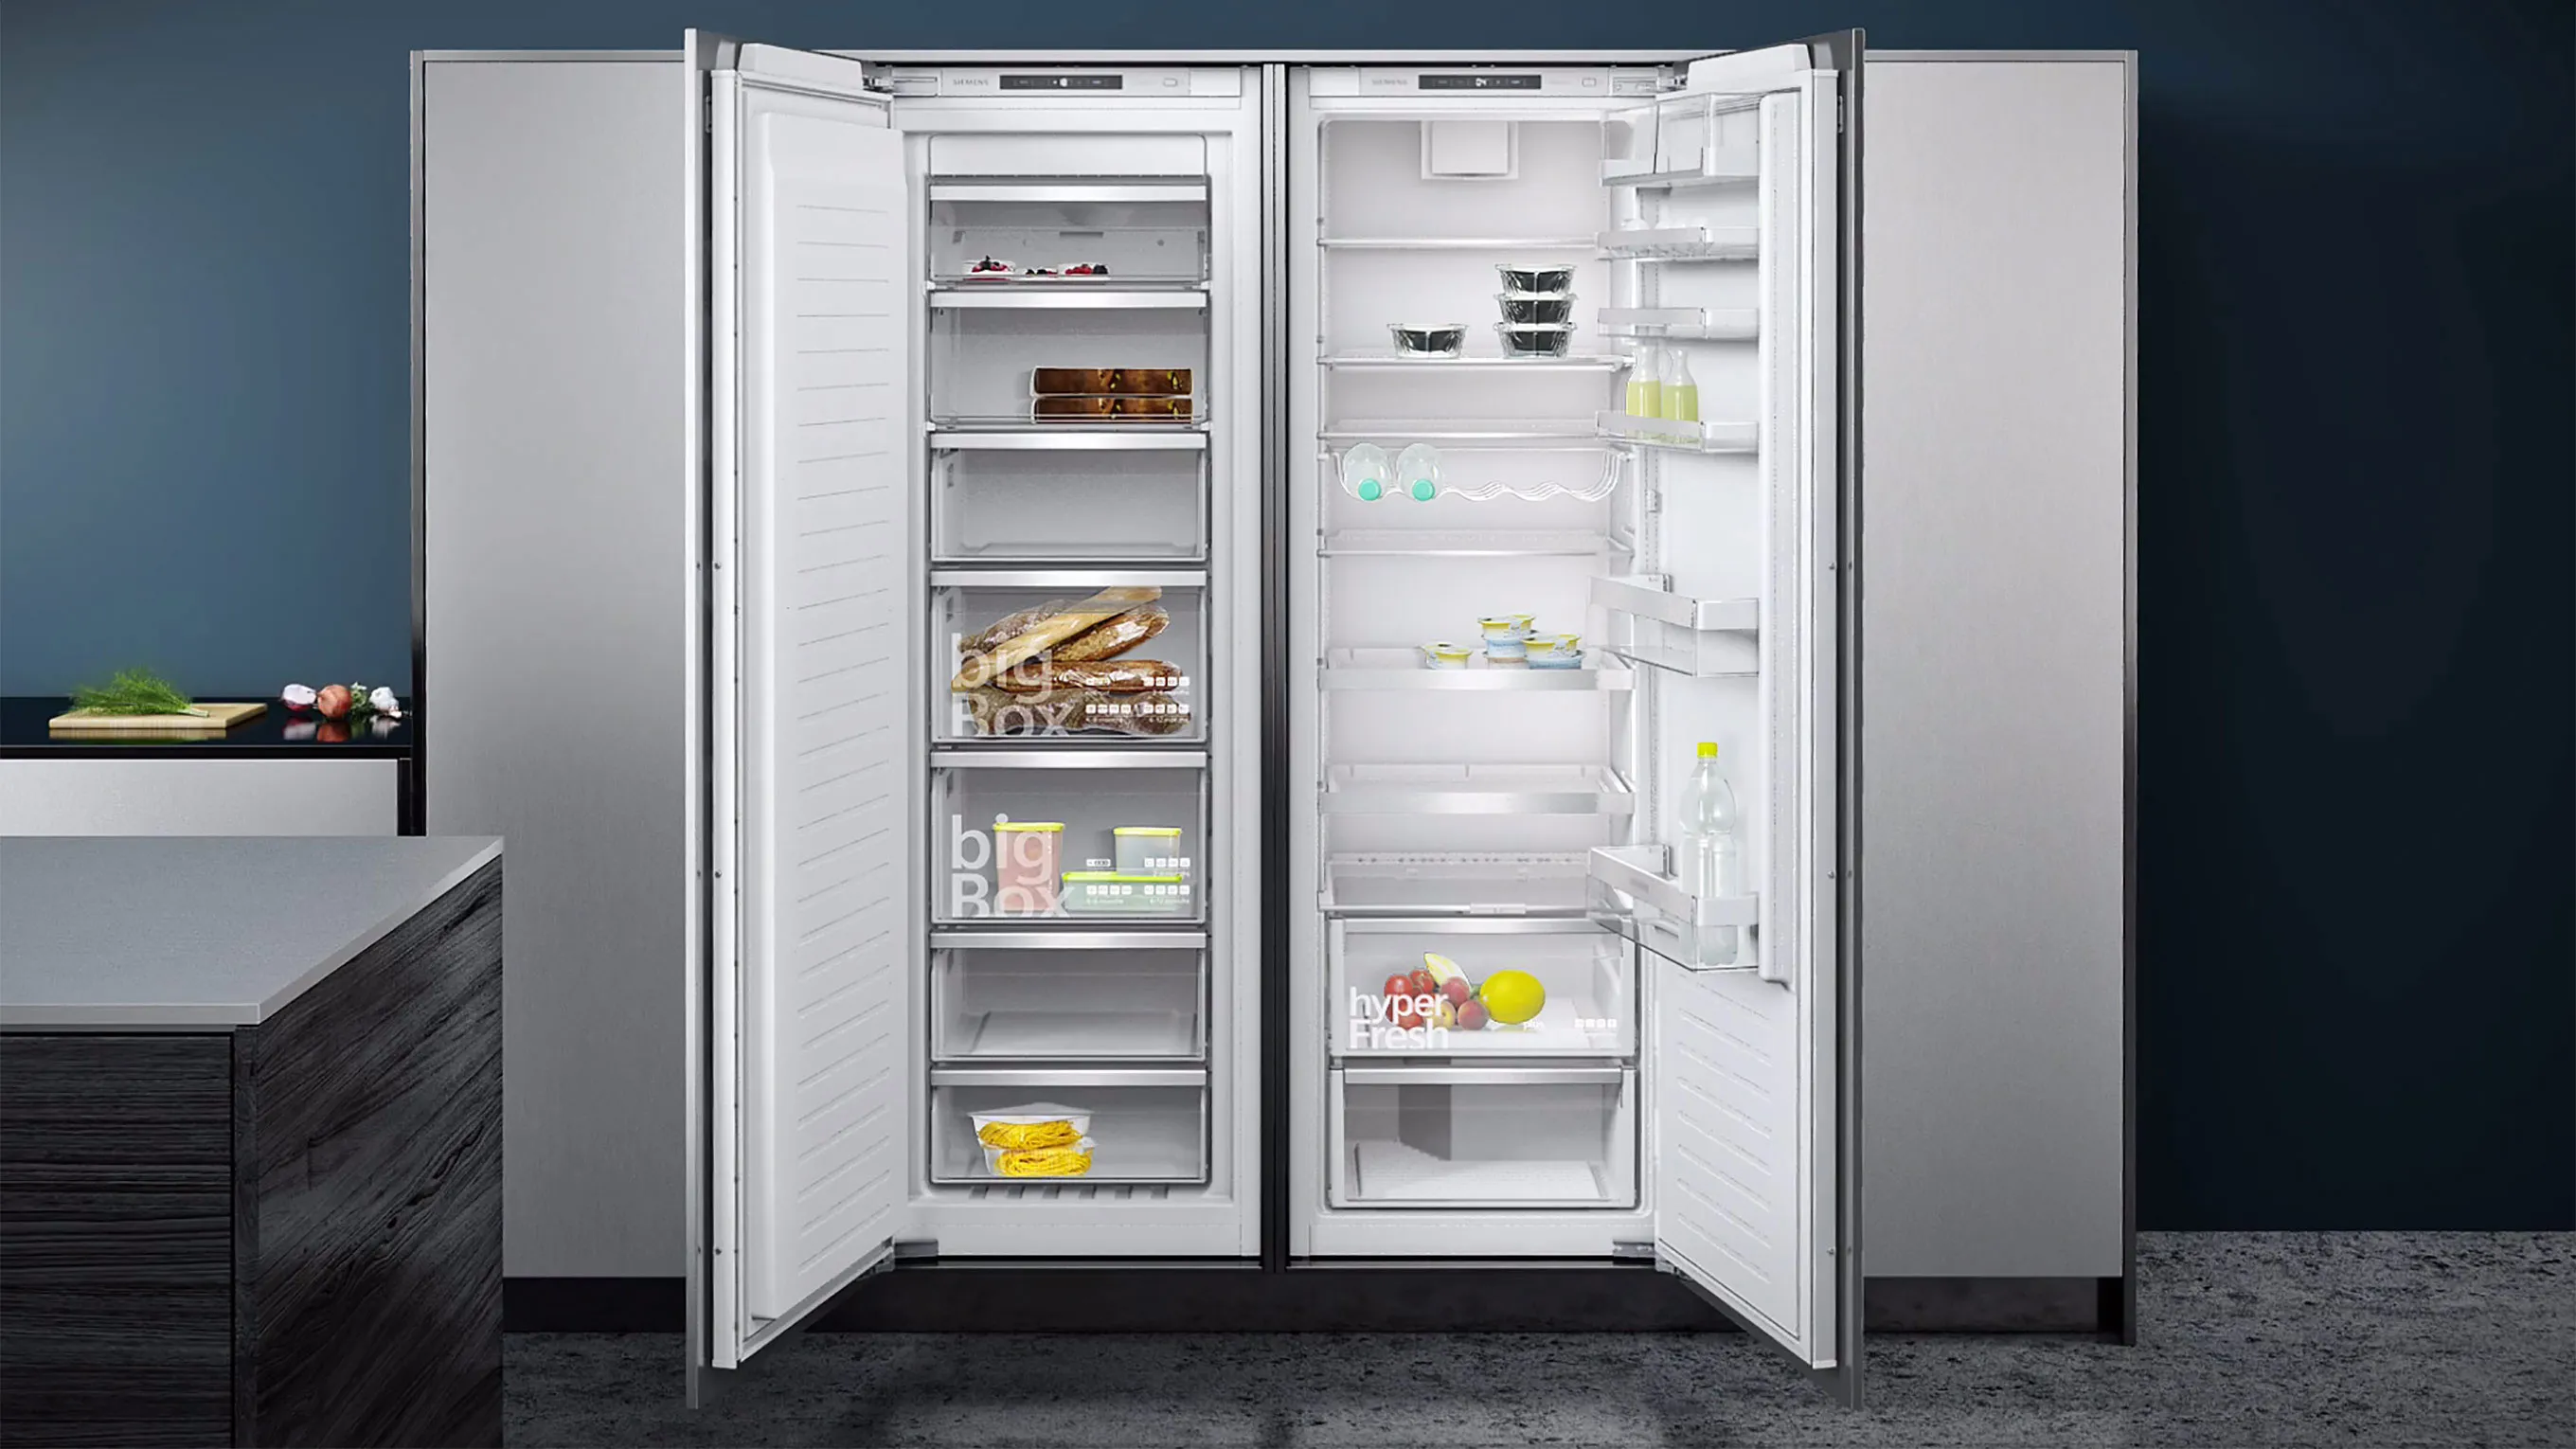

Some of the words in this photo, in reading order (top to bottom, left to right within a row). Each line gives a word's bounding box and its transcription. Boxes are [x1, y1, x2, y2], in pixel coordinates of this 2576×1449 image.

[951, 633, 1052, 705] big
[951, 692, 1075, 736] Box
[951, 813, 1053, 886] big
[951, 873, 1076, 918] Box
[1349, 986, 1449, 1025] hyper
[1349, 1017, 1450, 1049] Fresh
